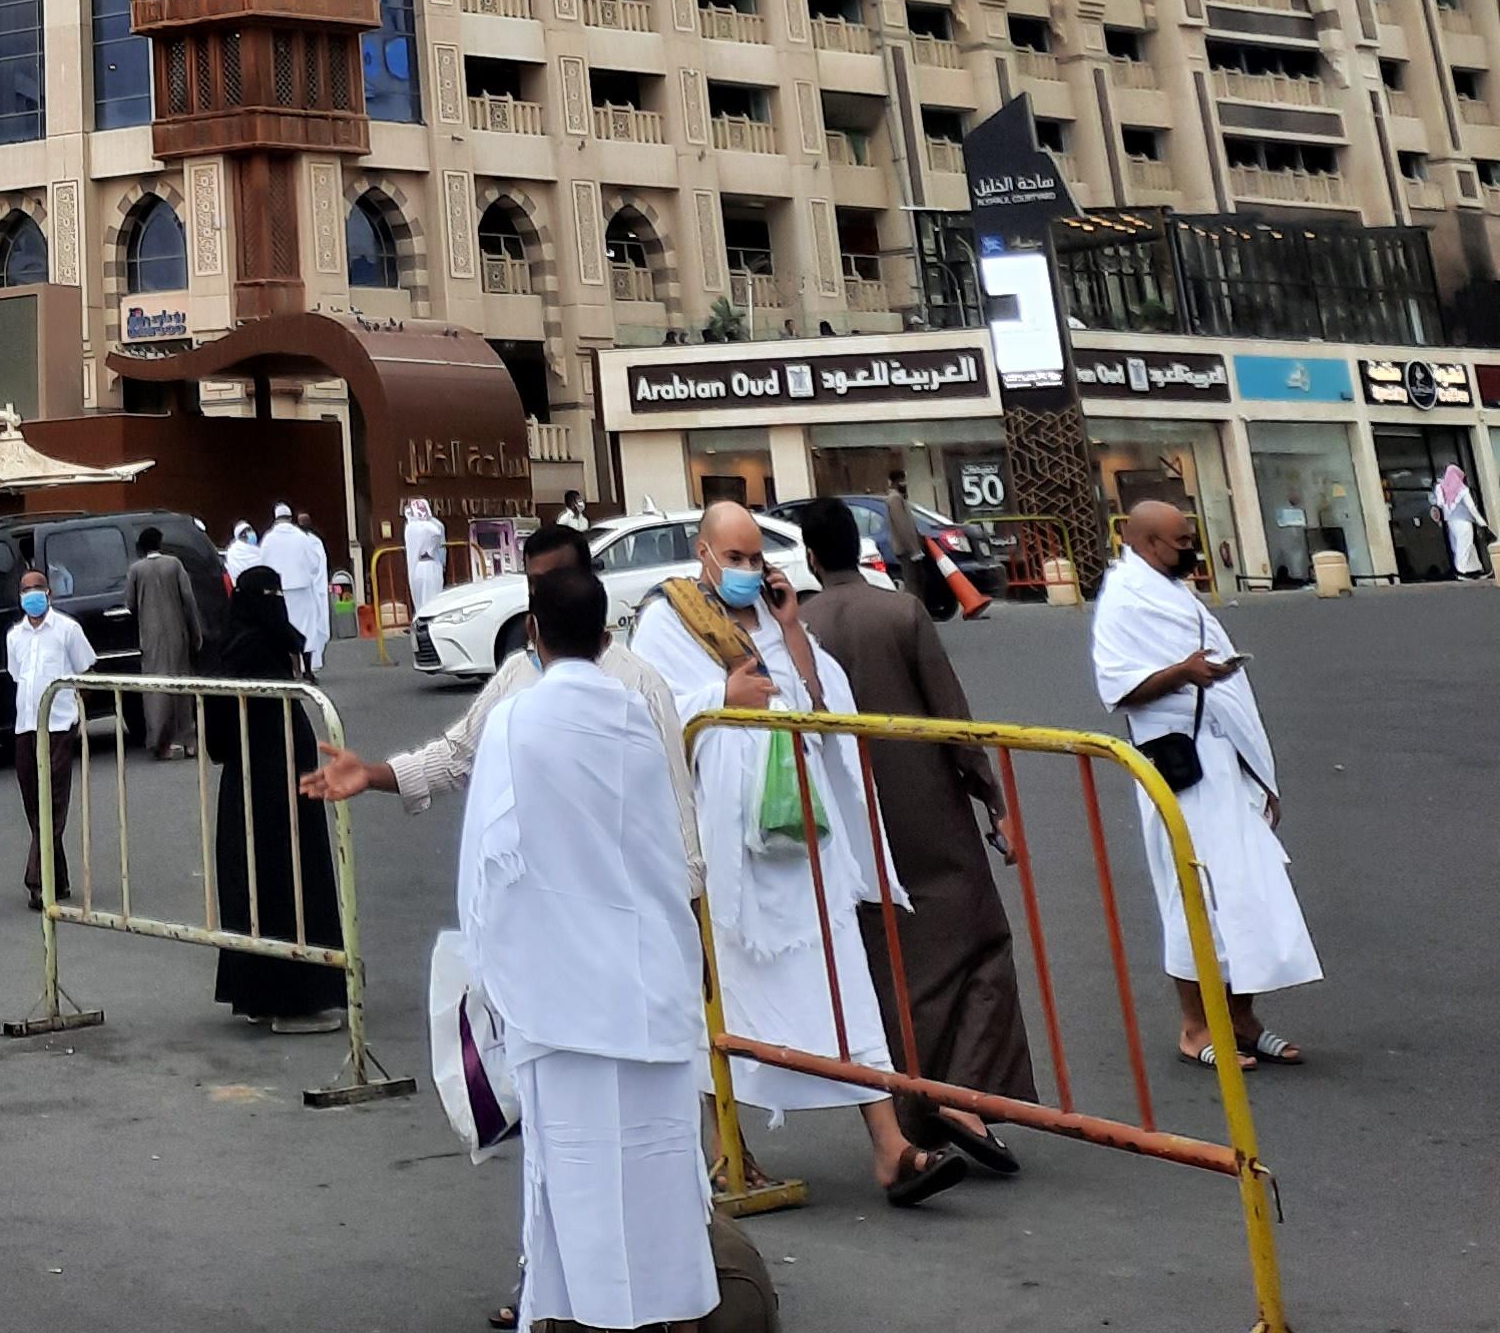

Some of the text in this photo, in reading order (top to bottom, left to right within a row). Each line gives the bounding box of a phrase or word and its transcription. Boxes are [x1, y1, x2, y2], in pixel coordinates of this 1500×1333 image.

[974, 173, 1055, 197] ساحة الخليل
[636, 368, 780, 401] Arabian Oud
[820, 360, 890, 394] للعود
[890, 355, 978, 391] العربية
[962, 474, 1005, 506] 50
